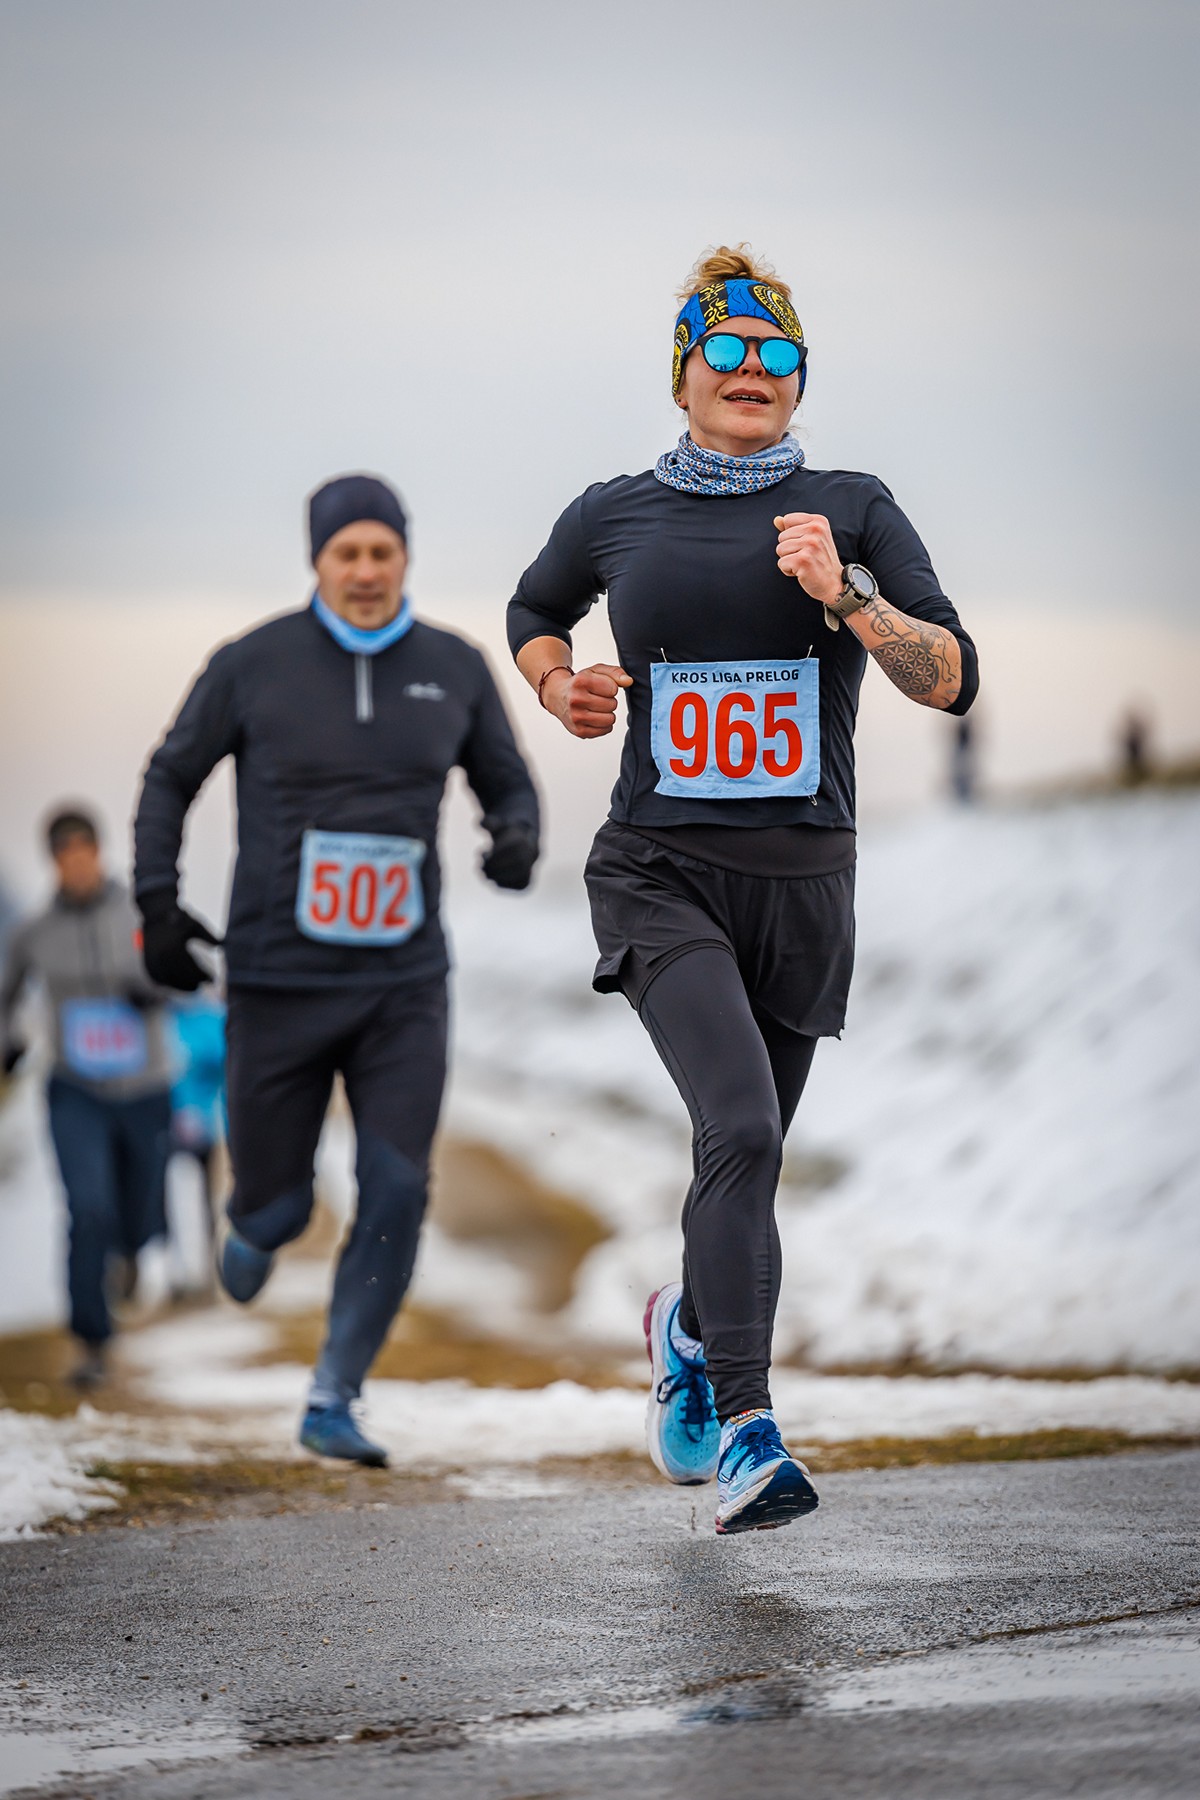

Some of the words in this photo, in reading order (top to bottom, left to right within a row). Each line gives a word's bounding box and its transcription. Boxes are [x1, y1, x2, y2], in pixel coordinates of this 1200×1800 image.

[671, 671, 708, 684] KROS
[712, 672, 743, 683] LIGA
[746, 669, 799, 682] PRELOG
[669, 691, 803, 779] 965
[310, 861, 410, 931] 502
